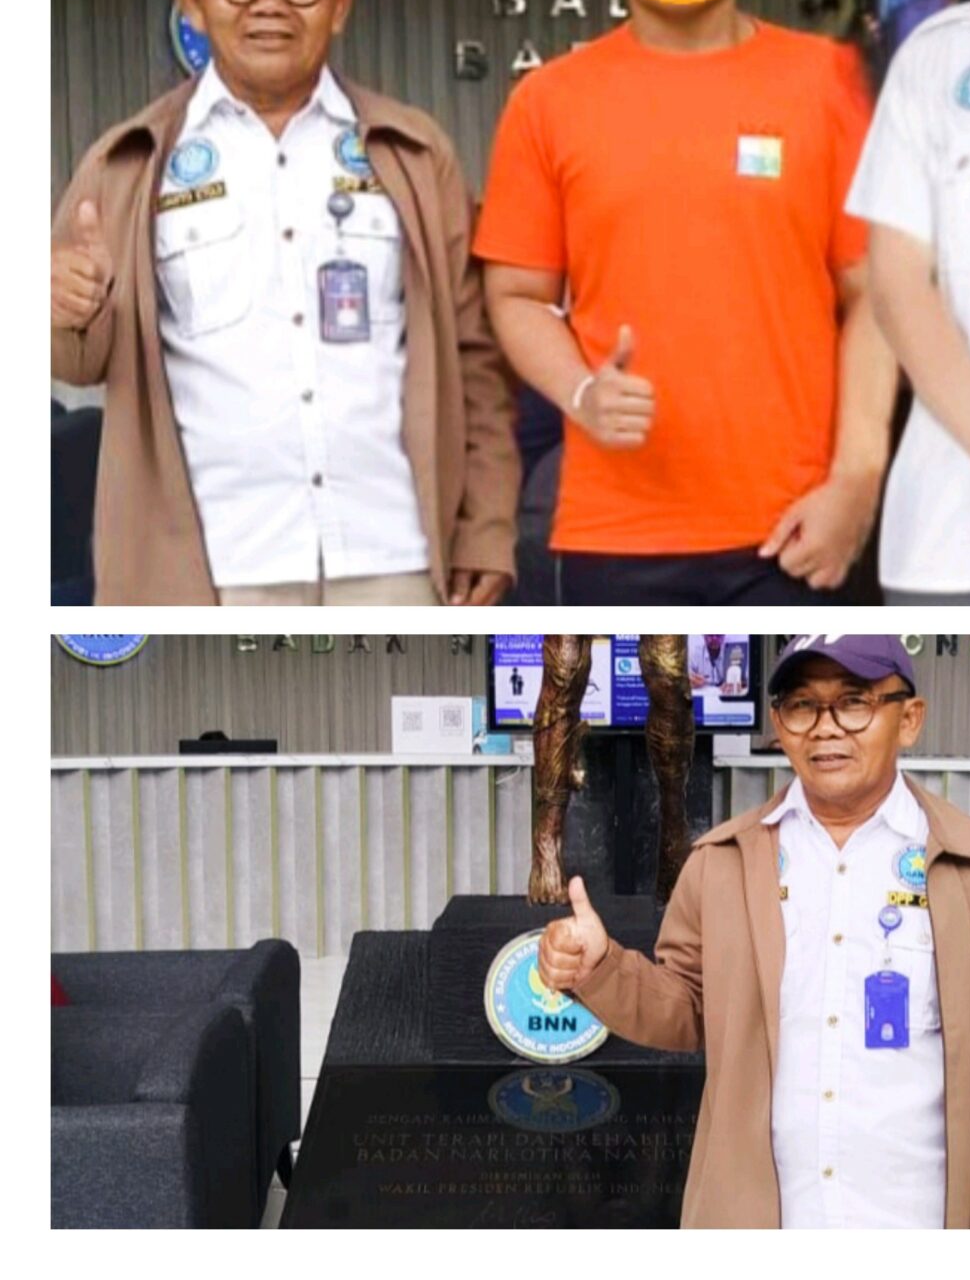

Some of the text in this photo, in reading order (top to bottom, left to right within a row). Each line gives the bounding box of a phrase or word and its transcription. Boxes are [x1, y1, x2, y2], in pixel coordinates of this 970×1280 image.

[528, 1015, 577, 1031] BNN
[353, 1133, 412, 1147] UNIT
[421, 1132, 504, 1146] TERAPI
[516, 1131, 566, 1145] DAN
[355, 1148, 440, 1162] BADAN
[450, 1148, 593, 1162] NARKOTIKA
